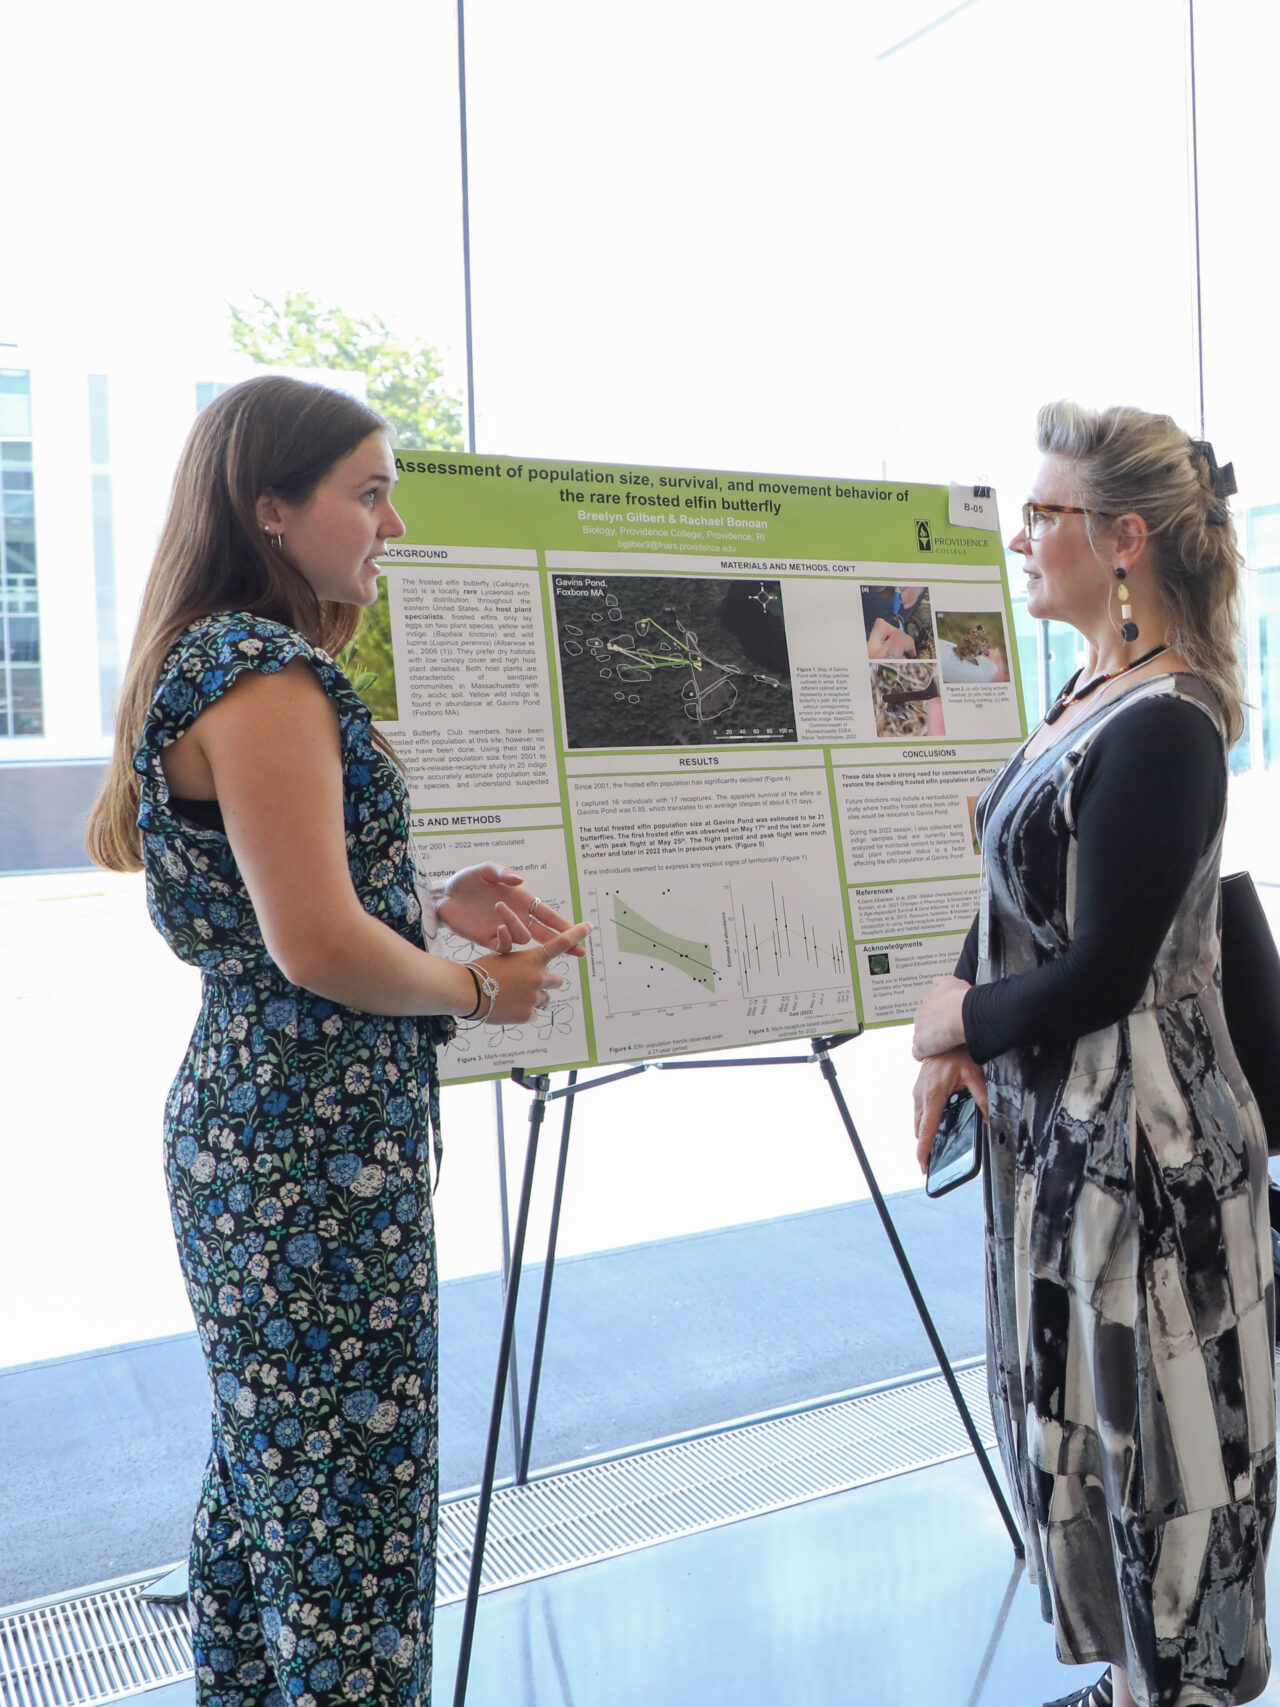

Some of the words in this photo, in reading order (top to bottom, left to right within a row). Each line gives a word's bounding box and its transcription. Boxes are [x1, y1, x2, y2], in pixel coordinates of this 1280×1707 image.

[395, 458, 501, 477] Assessment
[507, 464, 523, 477] of
[529, 467, 613, 485] population
[620, 475, 653, 487] size,
[659, 475, 722, 490] survival,
[728, 479, 753, 491] and
[759, 483, 831, 494] movement
[836, 486, 892, 499] behavior
[897, 490, 908, 501] of
[560, 489, 584, 502] the
[590, 494, 620, 503] rare
[625, 493, 679, 506] frosted
[685, 496, 716, 508] elfin
[722, 498, 780, 514] butterfly
[964, 503, 983, 513] B-05
[578, 511, 622, 523] Breelyn
[626, 512, 665, 522] Gilbert
[668, 514, 676, 523] &
[680, 515, 723, 525] Rachael
[727, 517, 767, 527] Bonoan
[582, 526, 617, 535] Biology,
[620, 527, 668, 535] Providence
[671, 529, 704, 539] College,
[706, 531, 753, 540] Providence,
[934, 538, 989, 547] PROVIDENCE
[383, 549, 448, 559] ACKGROUND
[452, 816, 501, 824] METHODS
[856, 888, 893, 896] References
[863, 940, 923, 952] Acknowledgments
